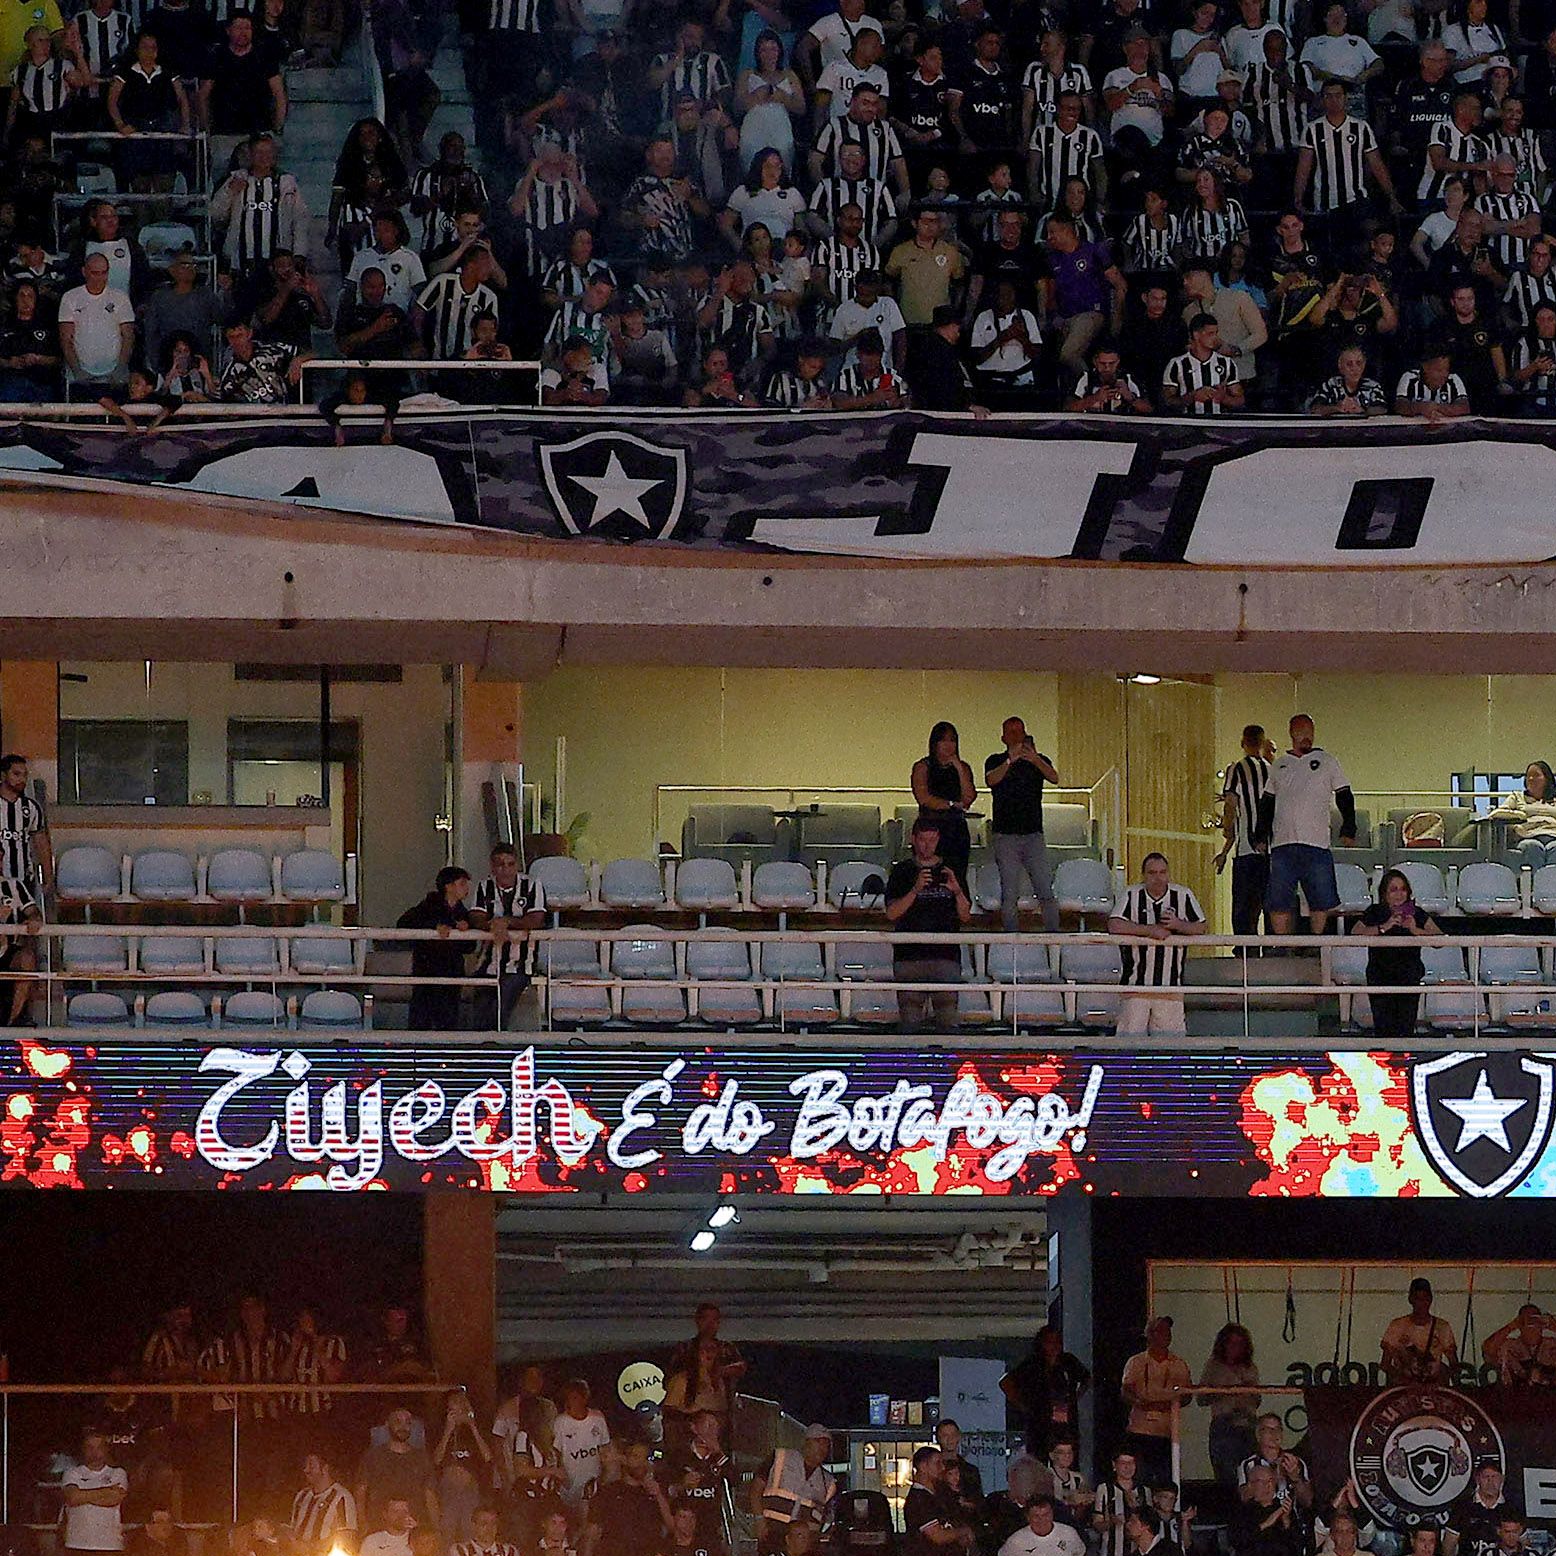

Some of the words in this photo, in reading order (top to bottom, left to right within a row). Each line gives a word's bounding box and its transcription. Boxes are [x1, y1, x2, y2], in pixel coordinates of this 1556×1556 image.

[911, 114, 938, 126] vbet
[604, 1058, 686, 1167] É
[682, 1077, 776, 1157] do
[789, 1063, 1105, 1181] Botafogo!
[623, 1375, 659, 1392] CAIXA
[686, 1487, 714, 1498] vbet
